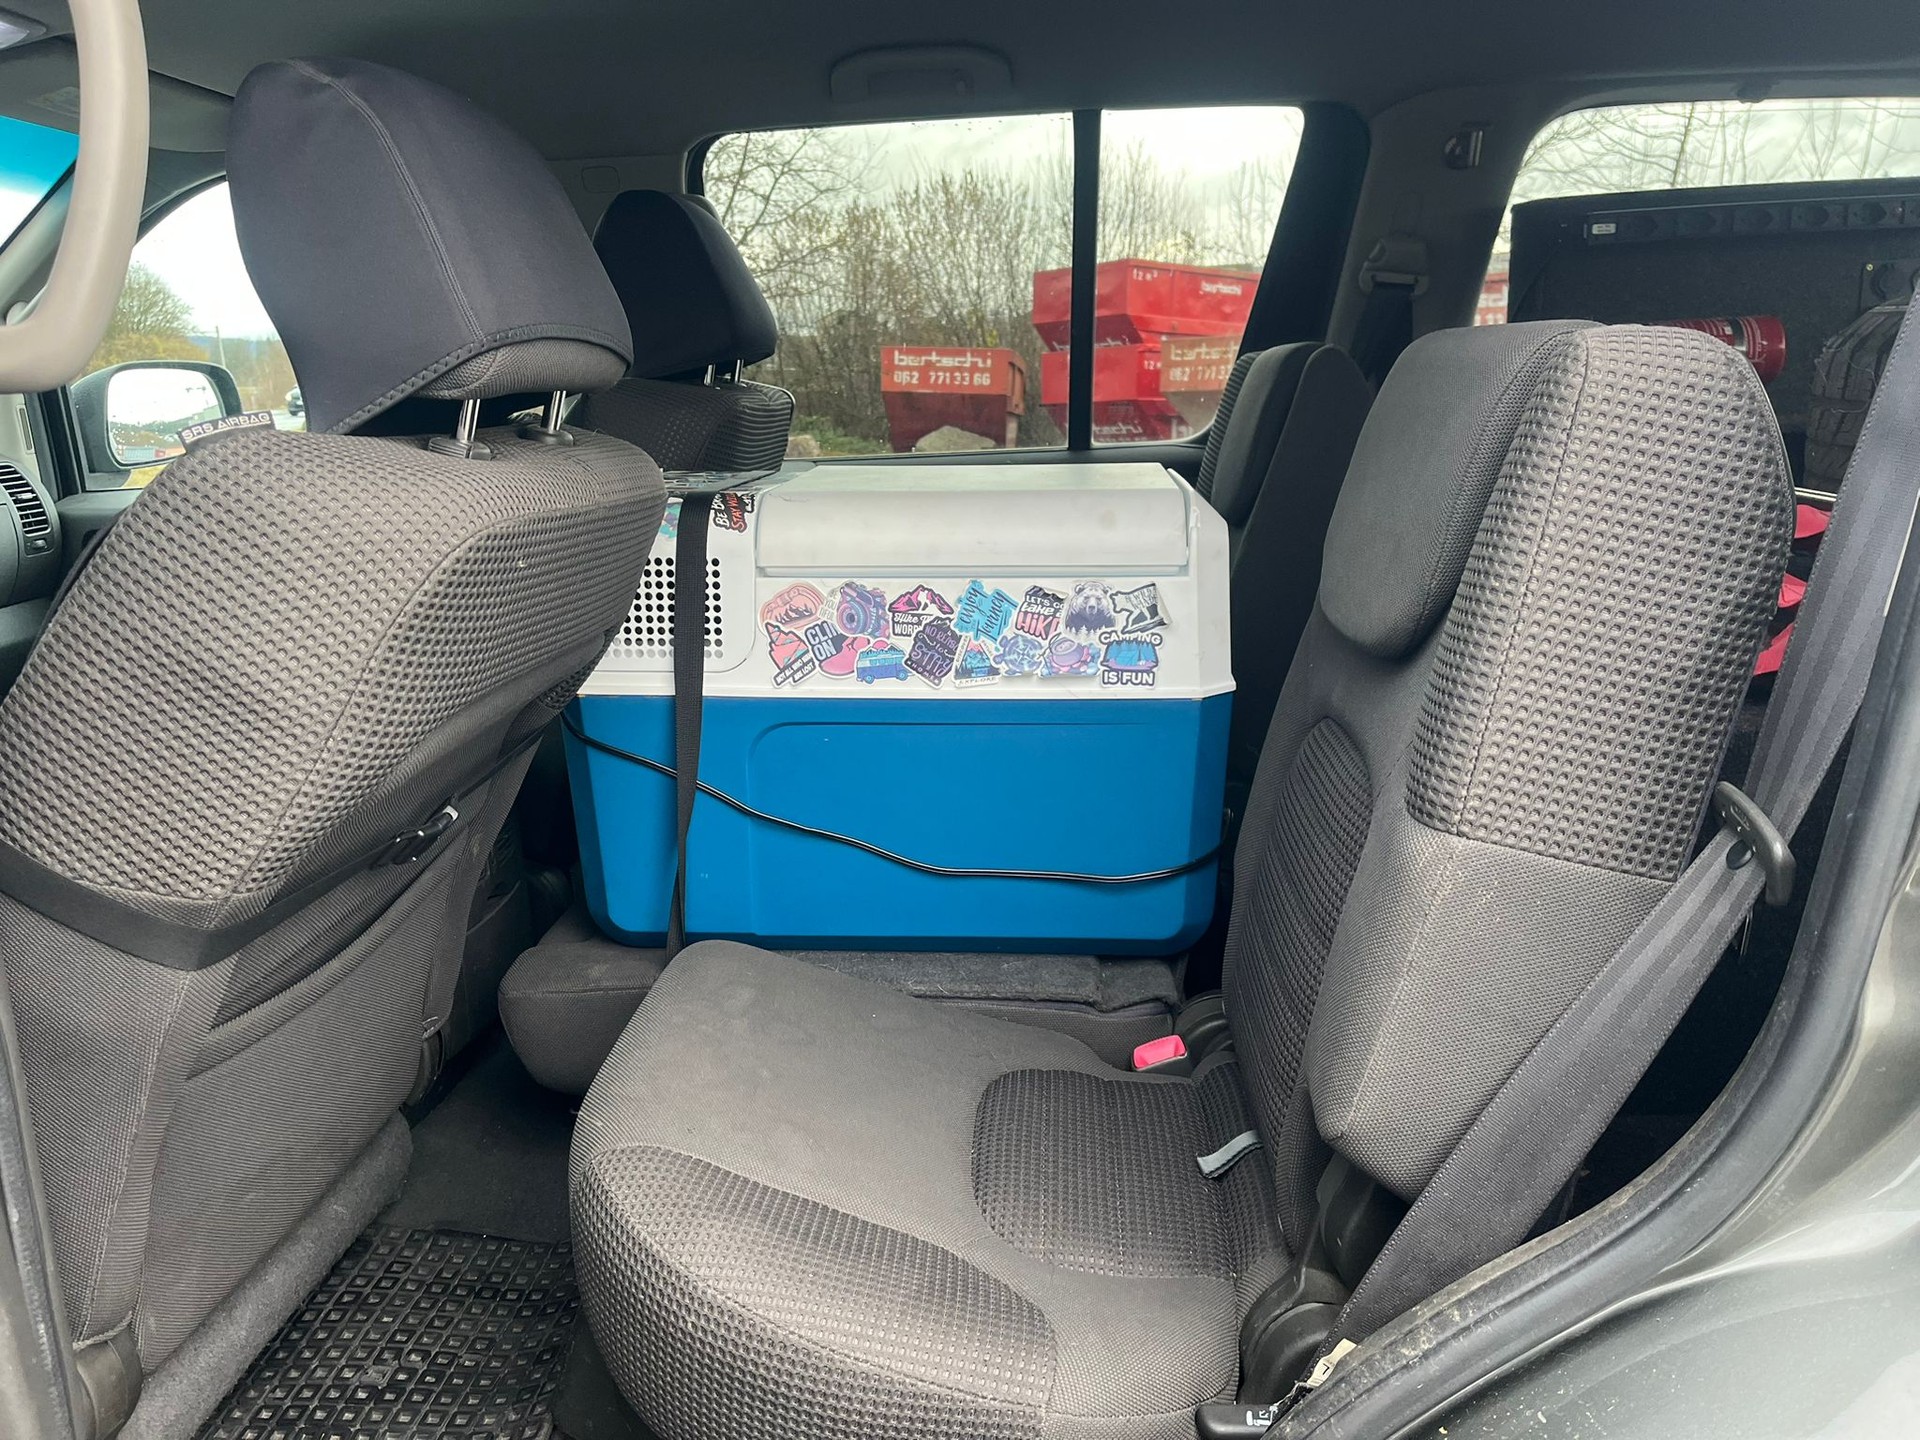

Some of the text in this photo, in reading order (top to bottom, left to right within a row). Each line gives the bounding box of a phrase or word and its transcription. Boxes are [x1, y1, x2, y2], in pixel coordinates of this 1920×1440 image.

[894, 350, 991, 368] bertschi
[929, 372, 951, 385] 771
[182, 413, 270, 440] SRS AIRBAG
[960, 587, 988, 624] enjoy
[1026, 595, 1050, 607] LET'S
[813, 639, 837, 661] ON
[1104, 671, 1154, 684] IS FUN
